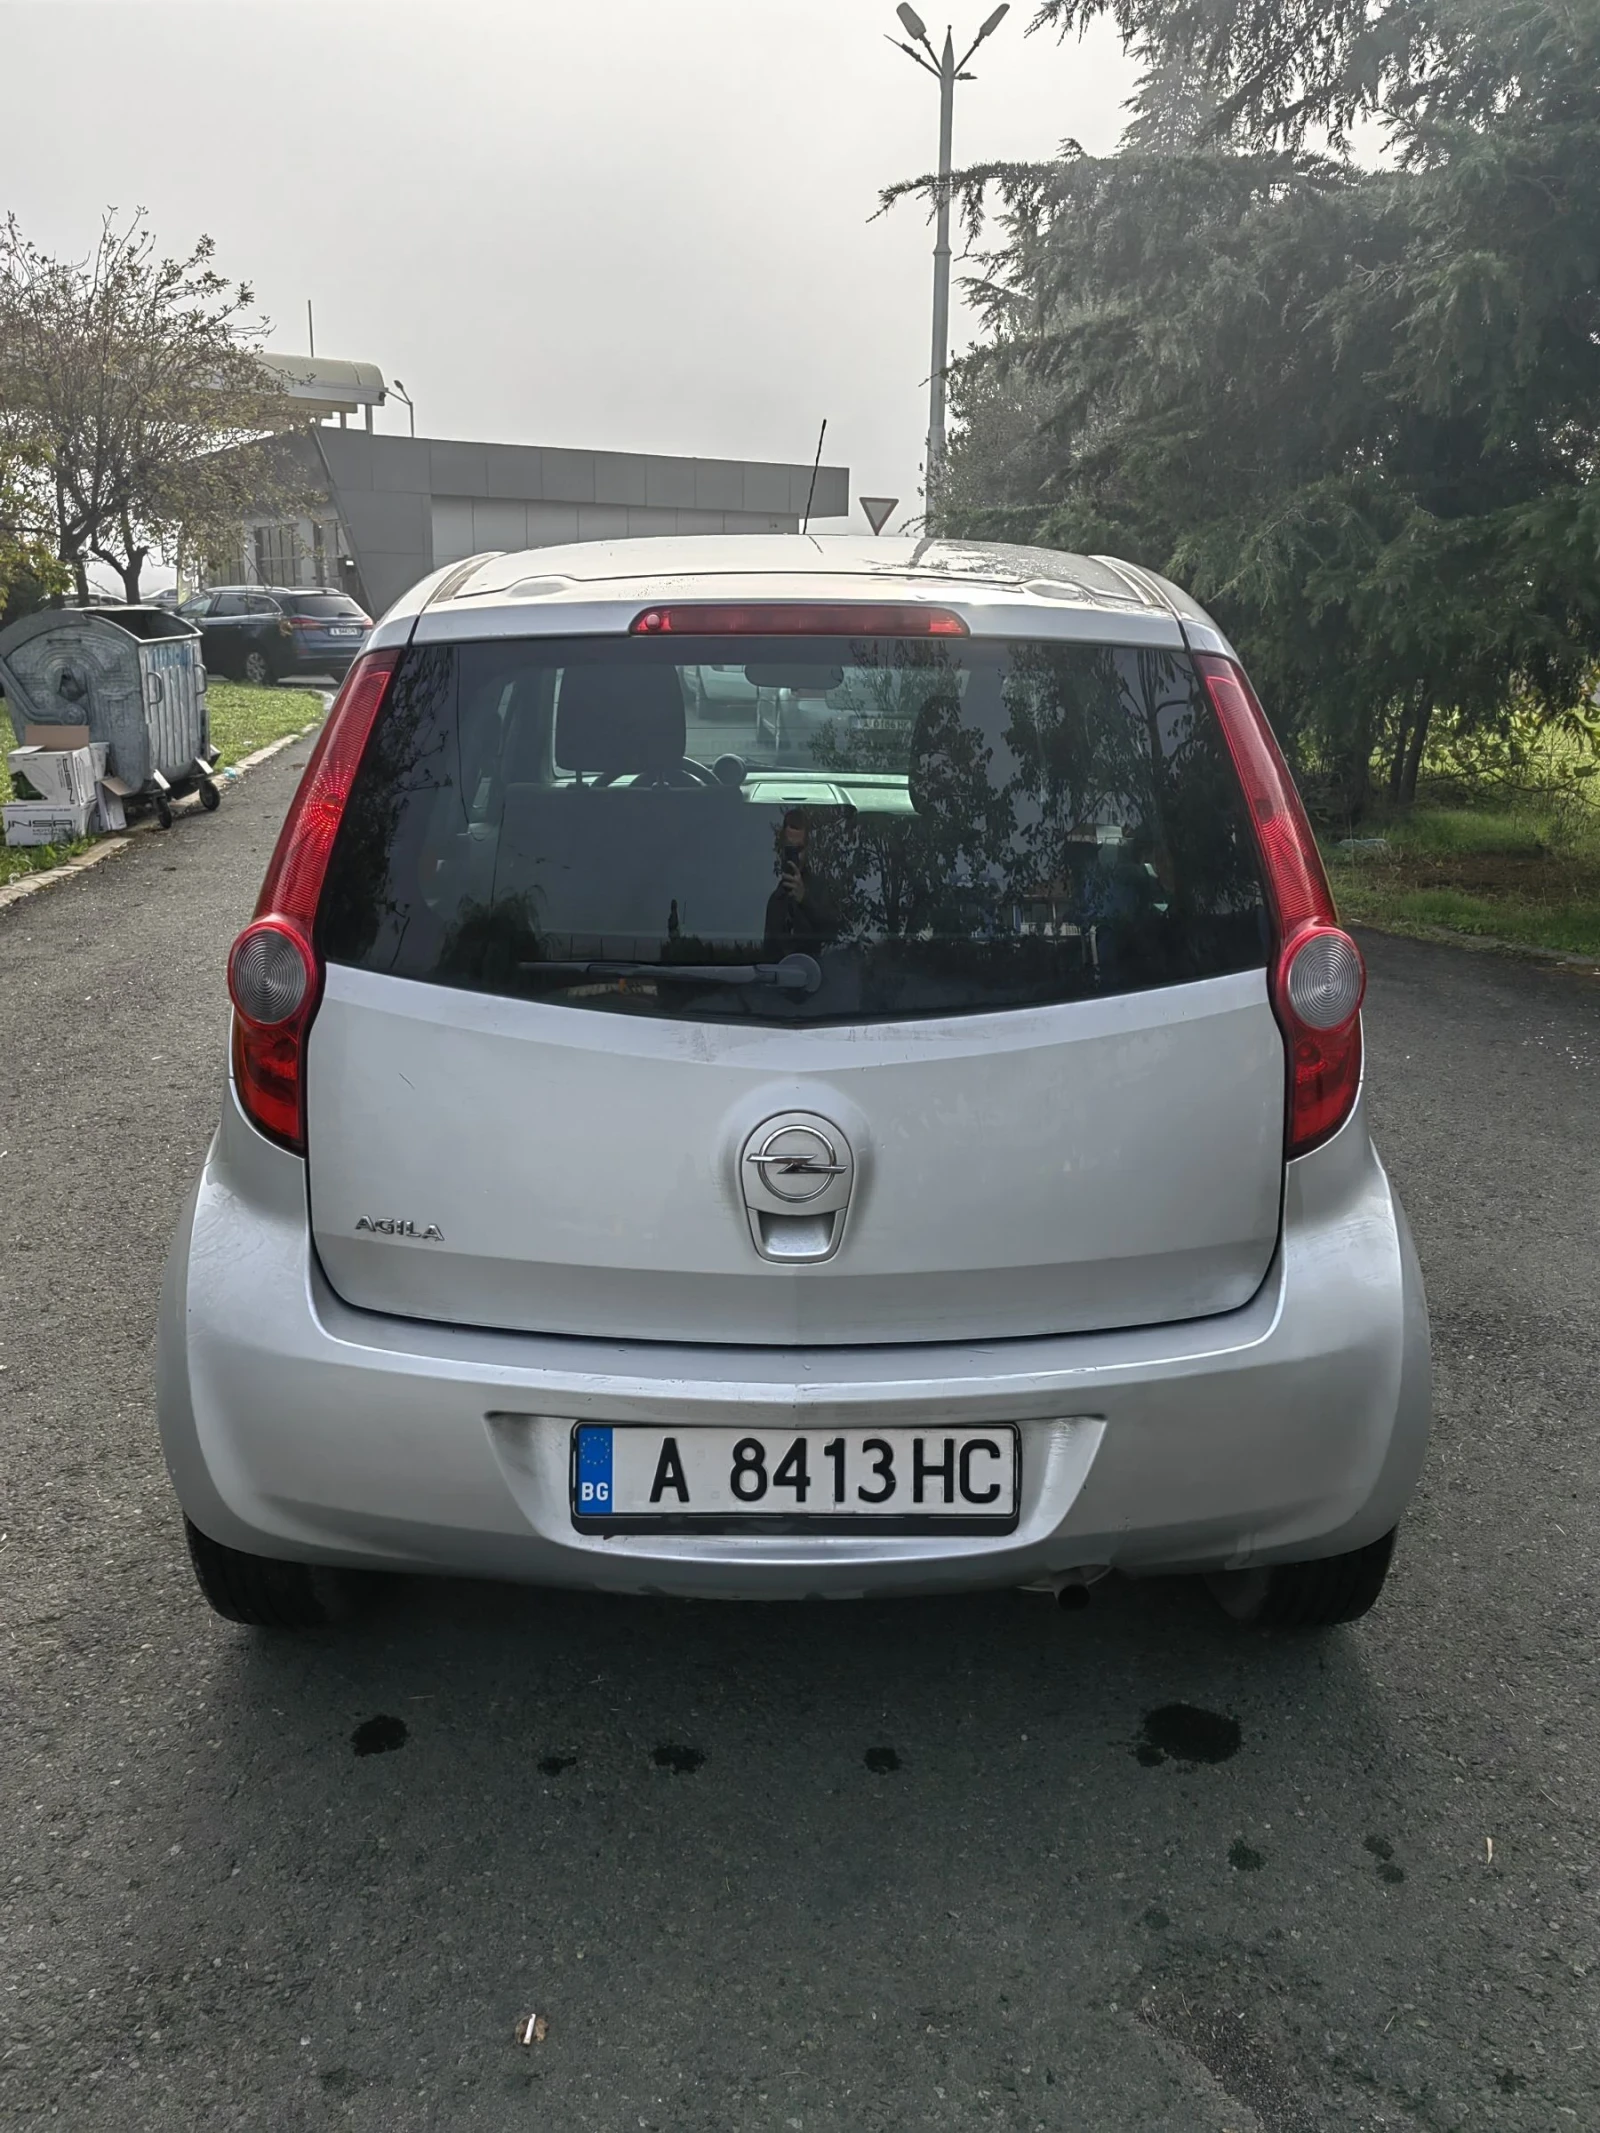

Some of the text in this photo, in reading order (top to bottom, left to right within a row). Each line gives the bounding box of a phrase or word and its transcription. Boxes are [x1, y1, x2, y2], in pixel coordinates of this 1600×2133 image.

[355, 1214, 445, 1241] AGILA
[649, 1437, 690, 1503] A
[581, 1482, 609, 1501] BG
